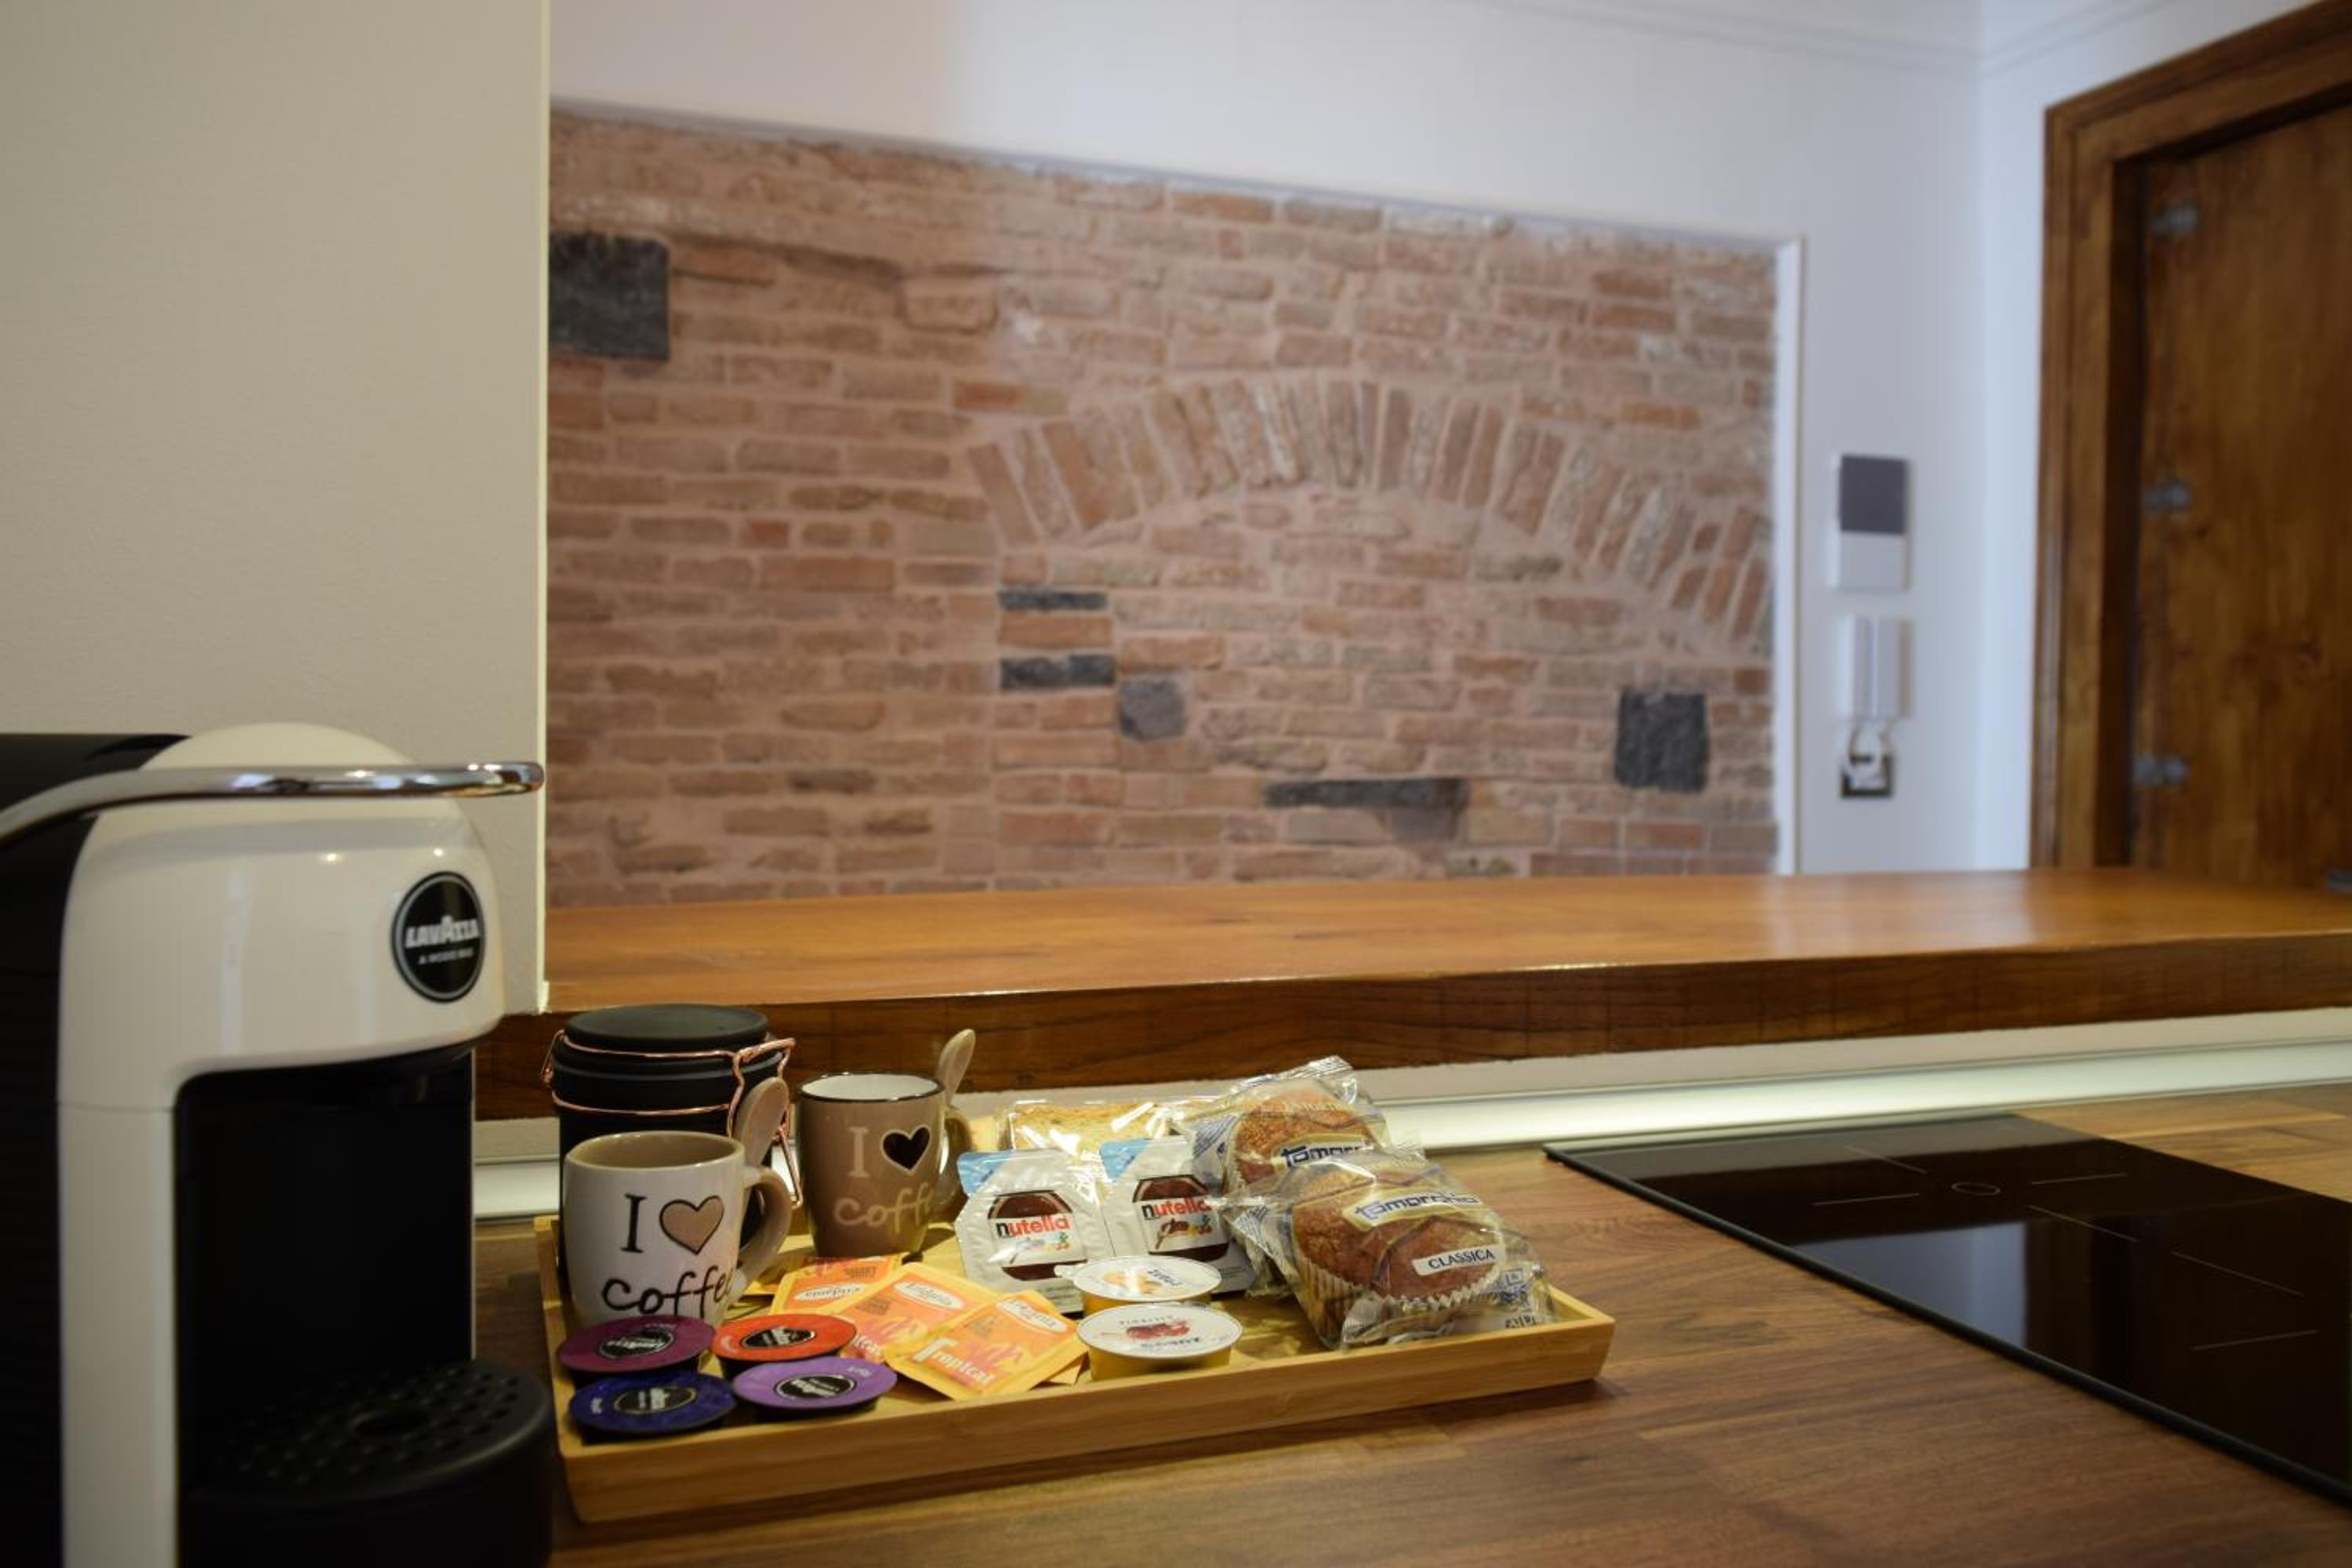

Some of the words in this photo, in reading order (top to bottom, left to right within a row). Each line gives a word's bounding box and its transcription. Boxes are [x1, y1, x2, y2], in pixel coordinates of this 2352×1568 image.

[848, 1126, 869, 1178] I
[620, 1193, 648, 1254] I
[996, 1214, 1071, 1239] nutella
[1428, 1248, 1496, 1270] CLASSICA
